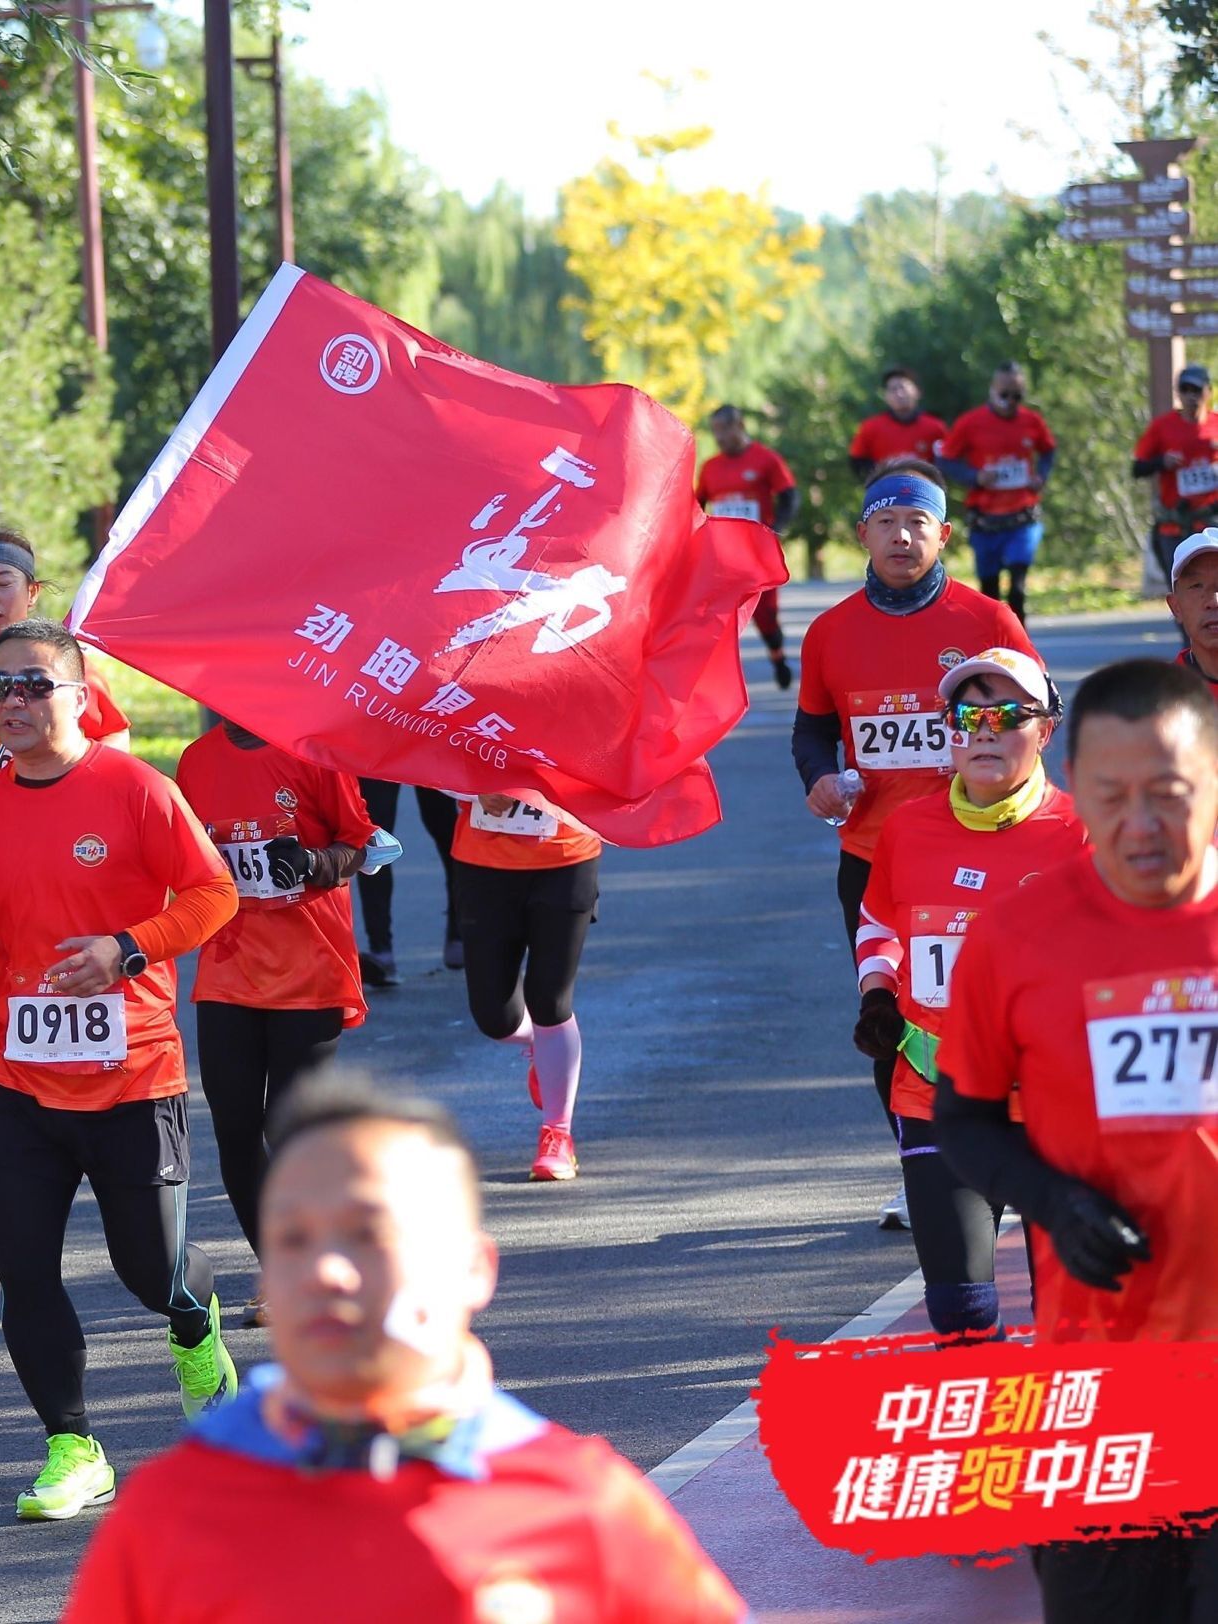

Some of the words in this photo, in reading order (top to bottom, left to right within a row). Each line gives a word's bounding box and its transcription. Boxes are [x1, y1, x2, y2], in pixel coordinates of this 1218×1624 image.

[287, 651, 338, 688] JIN
[343, 681, 448, 738] RUNNING
[448, 731, 508, 769] CLUB
[859, 719, 946, 754] 2945
[17, 1002, 110, 1044] 0918
